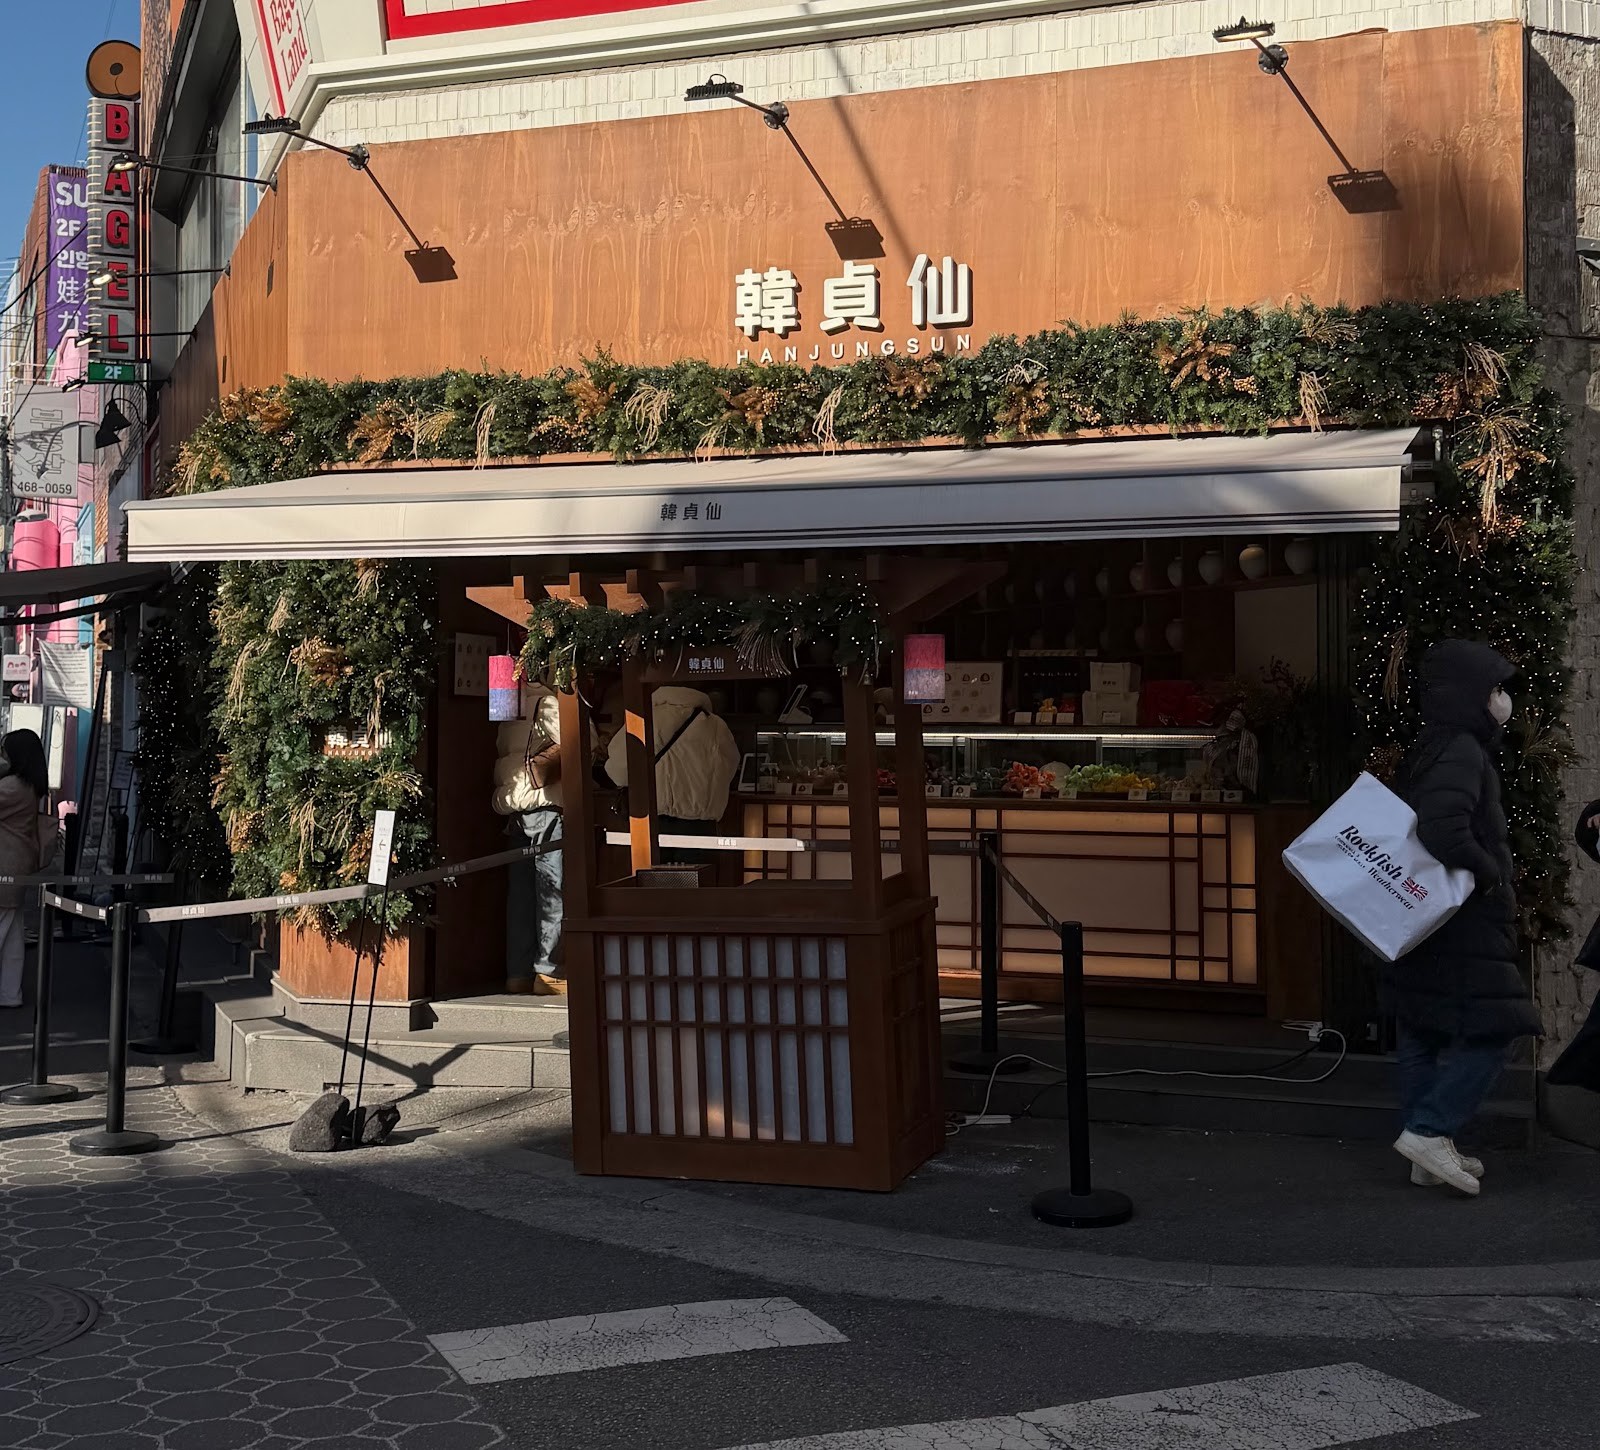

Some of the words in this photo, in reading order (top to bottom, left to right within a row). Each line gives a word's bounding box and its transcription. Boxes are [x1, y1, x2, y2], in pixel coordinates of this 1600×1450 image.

[281, 9, 307, 92] Land
[56, 218, 81, 237] 2F
[104, 103, 132, 353] BAGEL
[734, 253, 973, 337] 韓貞仙
[736, 333, 971, 365] HANJUNGSUN
[104, 365, 123, 380] 2F
[18, 481, 72, 495] 468-0059
[660, 501, 722, 521] 韓貞仙
[1339, 825, 1403, 881] Rockfish
[1368, 866, 1415, 910] Weatherwear
